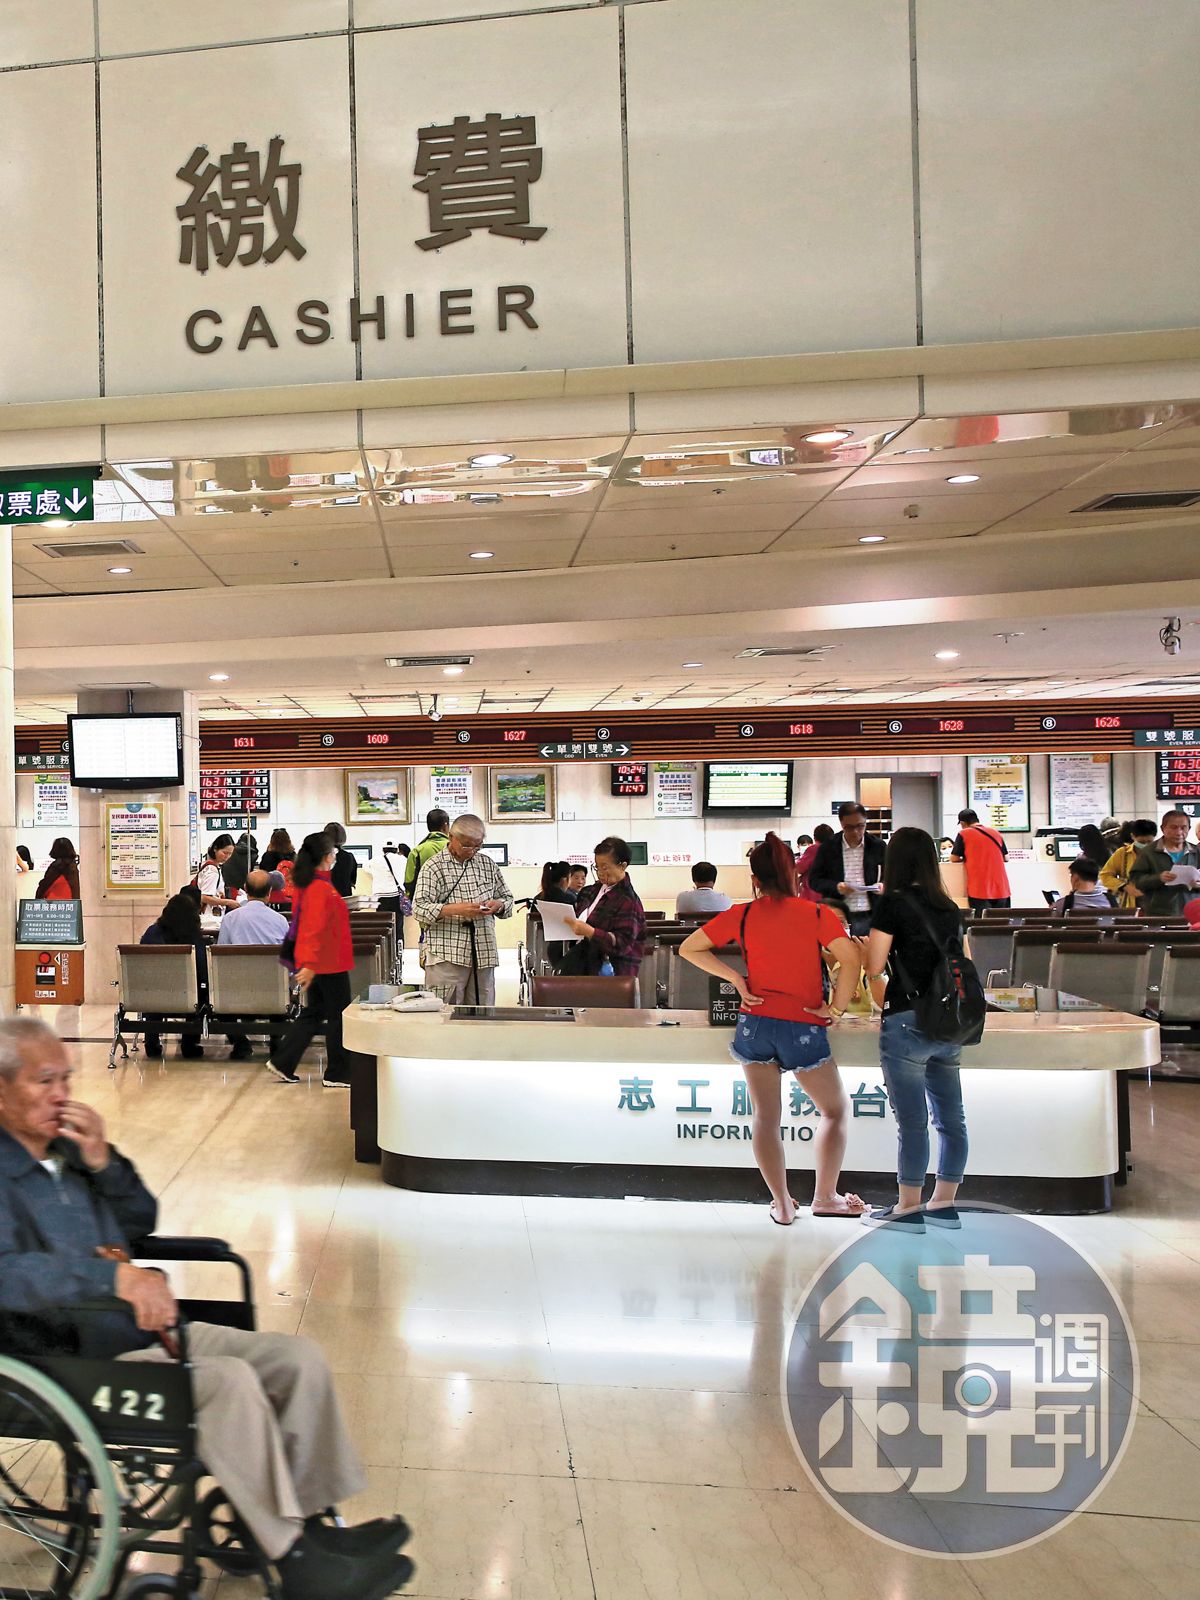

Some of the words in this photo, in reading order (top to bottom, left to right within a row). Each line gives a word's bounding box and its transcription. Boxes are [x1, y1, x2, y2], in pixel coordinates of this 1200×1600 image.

[176, 113, 548, 271] 繳費
[185, 285, 539, 355] CASHIER
[939, 720, 964, 731] 1628
[1095, 717, 1120, 728] 1626
[789, 724, 814, 734] 1618
[367, 733, 389, 744] 1609
[503, 730, 526, 741] 1627
[233, 737, 255, 748] 1631
[557, 744, 582, 754] 單號
[588, 743, 613, 754] 雙號
[18, 755, 70, 766] 單號服務
[202, 777, 227, 787] 1631
[202, 788, 227, 798] 1629
[250, 788, 256, 797] 7
[620, 784, 645, 793] 11:47
[202, 800, 227, 810] 1627
[1046, 844, 1055, 856] 8
[712, 1000, 739, 1012] 志工
[676, 1123, 817, 1141] INFORMTIO
[91, 1385, 165, 1421] 422
